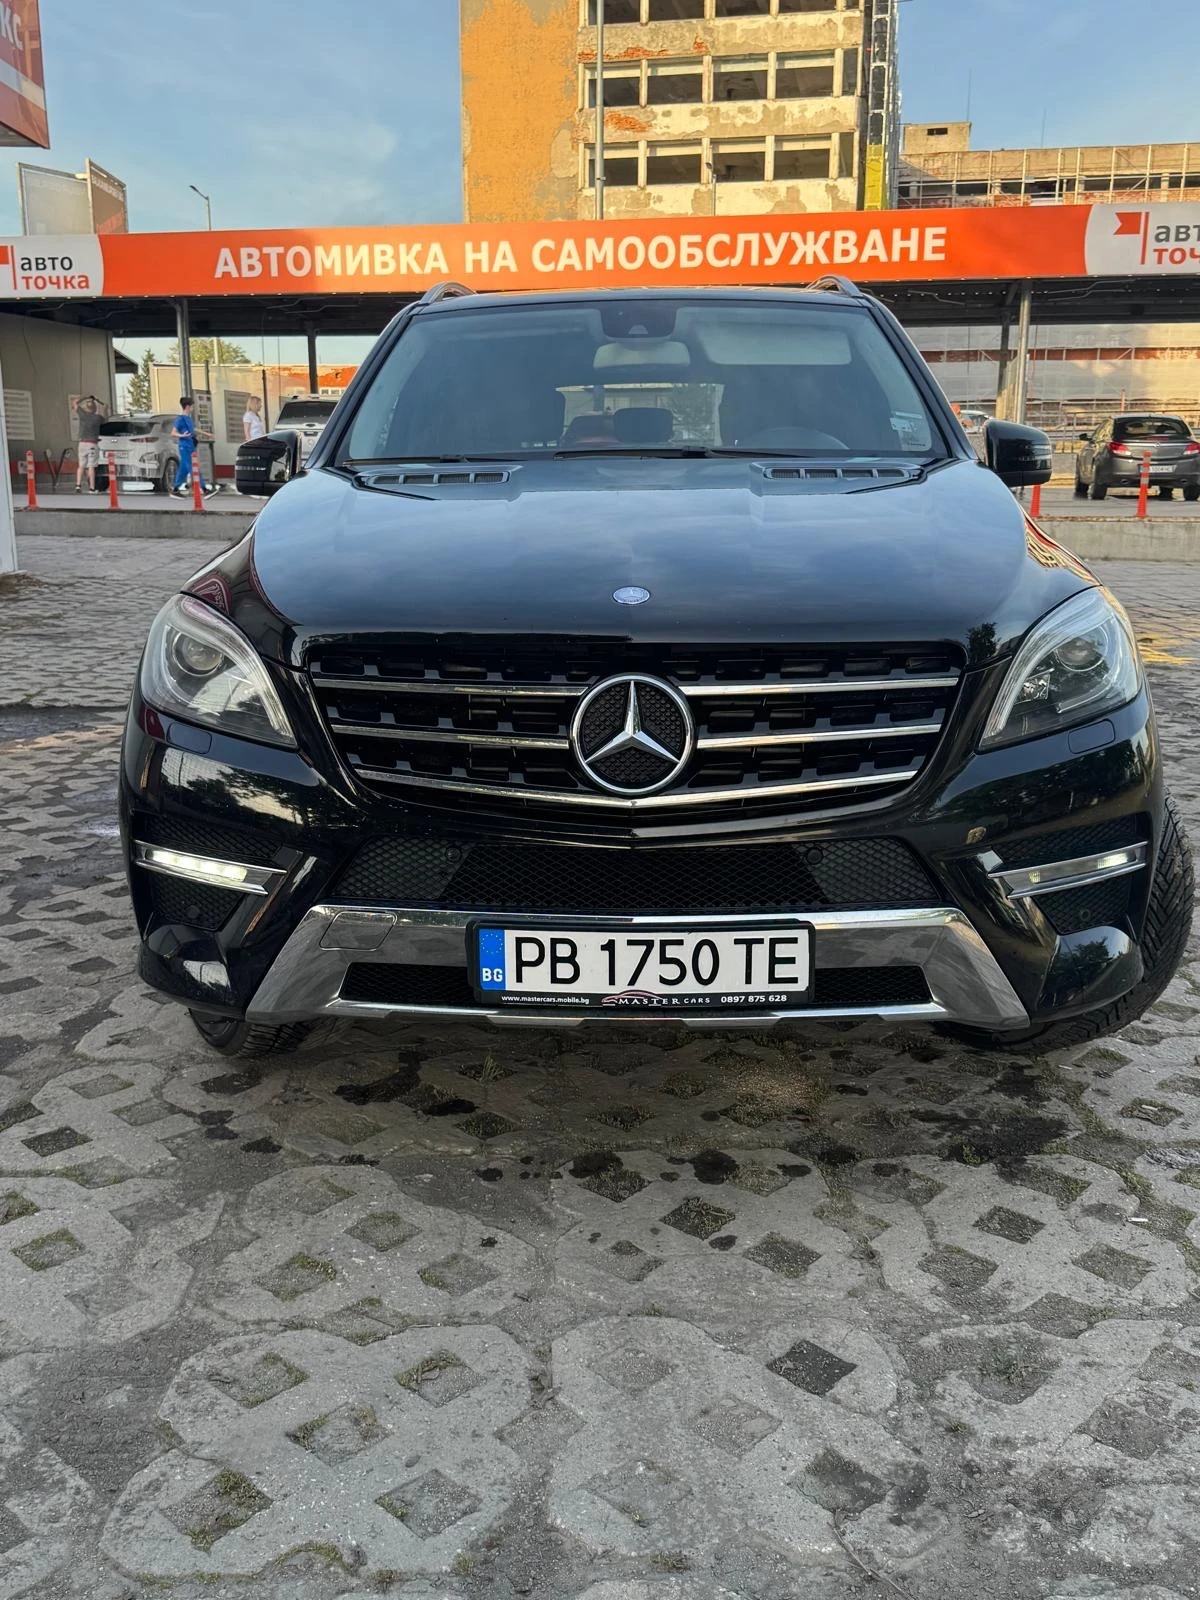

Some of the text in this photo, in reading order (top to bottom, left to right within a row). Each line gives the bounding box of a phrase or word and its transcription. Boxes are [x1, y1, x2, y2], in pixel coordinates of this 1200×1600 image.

[214, 226, 947, 278] АВТОМИВКА НА САМООБСЛУЖВАНЕ
[20, 256, 73, 271] авто
[21, 274, 90, 290] точка
[515, 936, 799, 987] PB 1750 TE
[481, 967, 503, 982] BG
[501, 995, 590, 1005] www.mastercars.mobile.bg
[720, 994, 787, 1003] 0897 875 628
